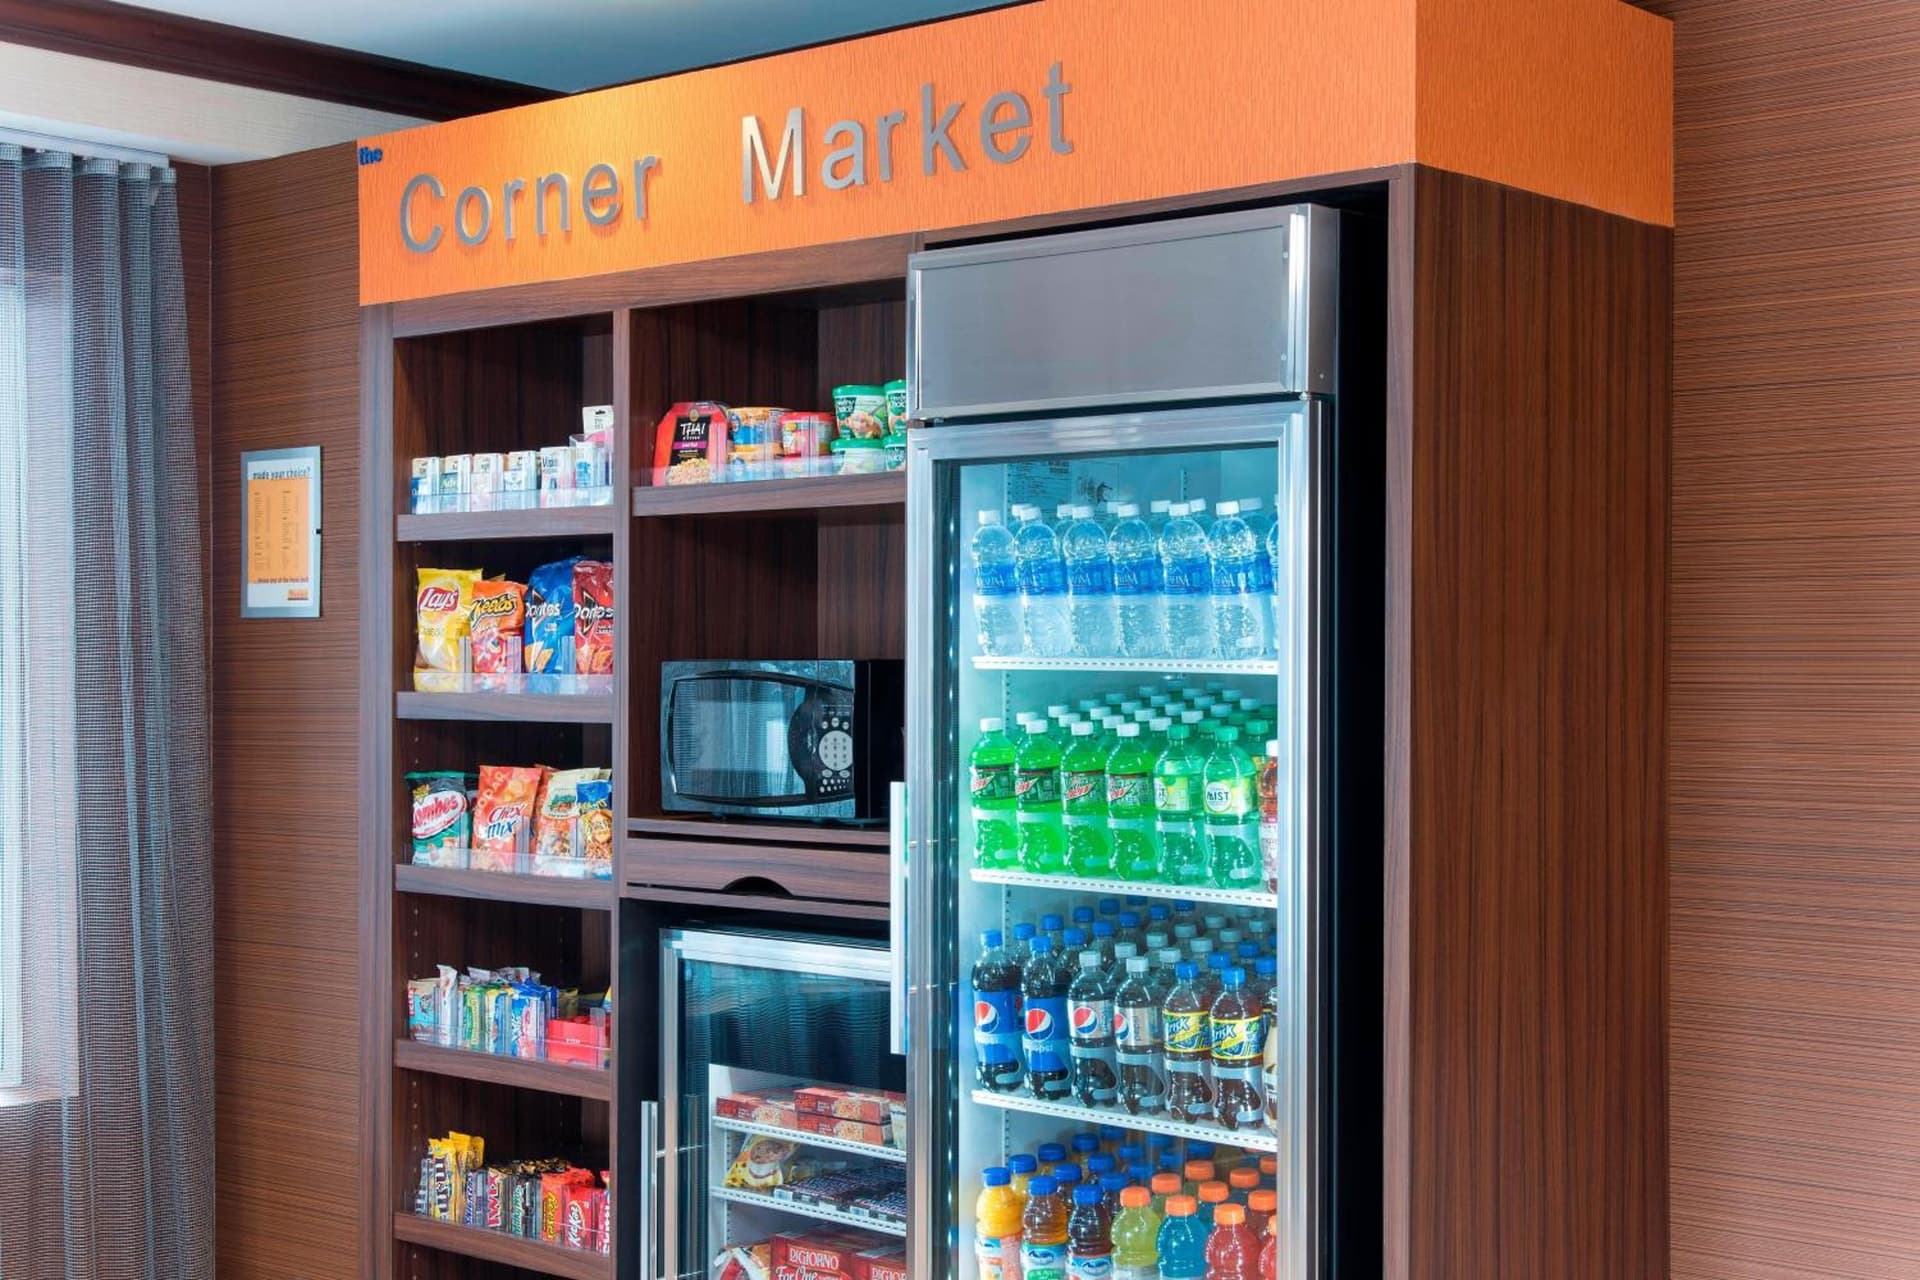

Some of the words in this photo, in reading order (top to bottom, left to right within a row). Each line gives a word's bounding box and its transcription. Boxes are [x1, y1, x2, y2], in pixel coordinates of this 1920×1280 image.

[359, 146, 383, 165] the
[400, 153, 661, 255] Corner
[741, 61, 1074, 204] Market
[680, 422, 706, 438] THAI
[420, 587, 459, 611] Lay's
